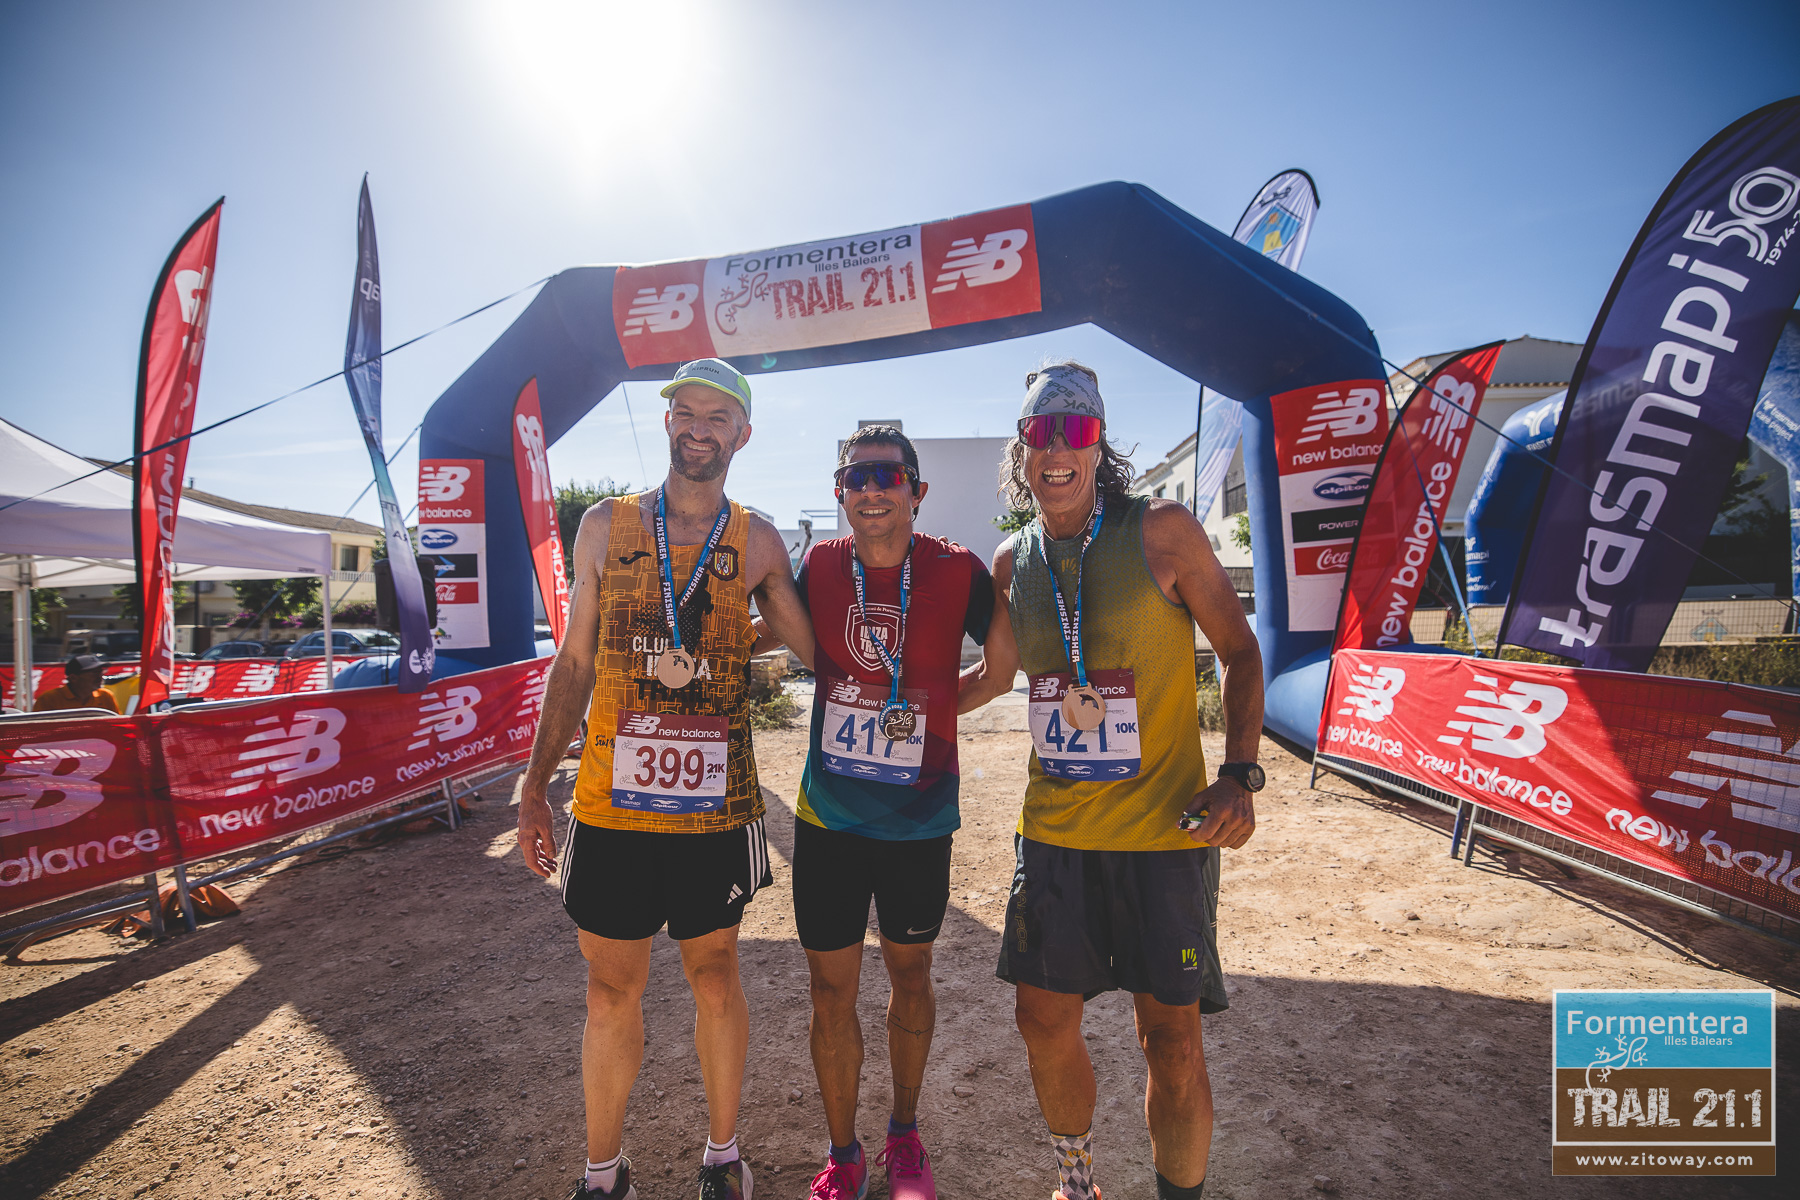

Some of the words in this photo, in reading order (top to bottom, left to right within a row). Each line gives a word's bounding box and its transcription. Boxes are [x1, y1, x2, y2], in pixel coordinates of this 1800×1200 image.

[724, 232, 912, 276] Formentera
[814, 261, 840, 274] Illes
[842, 252, 890, 270] Balears
[931, 228, 1028, 295] NB
[622, 283, 699, 337] NB
[767, 272, 853, 320] TRAIL
[860, 261, 917, 309] 21.1
[1296, 388, 1380, 444] NB
[1292, 448, 1326, 466] new
[1539, 253, 1750, 648] trasmapi
[427, 507, 472, 519] balance
[708, 513, 729, 549] FINISHER
[1319, 519, 1359, 531] POWER
[1391, 462, 1452, 588] balance
[656, 517, 668, 560] FINISHER
[663, 581, 676, 628] FINISHER
[1056, 592, 1071, 641] FINISHER
[1377, 592, 1409, 646] new
[632, 636, 669, 653] CLU
[1072, 610, 1080, 663] FINISHER
[859, 698, 878, 707] new
[1095, 686, 1126, 696] lance
[407, 685, 482, 751] NB
[507, 723, 532, 742] new
[622, 714, 661, 735] NB
[658, 728, 680, 737] new
[682, 728, 720, 738] balance
[1115, 722, 1138, 734] 10K
[1437, 674, 1568, 759] NB
[225, 707, 347, 798] NB
[906, 735, 923, 745] 10K
[396, 756, 437, 782] new
[634, 745, 705, 791] 399
[1454, 758, 1574, 817] balance
[199, 802, 270, 839] new
[273, 774, 376, 820] balance
[1605, 807, 1690, 853] new
